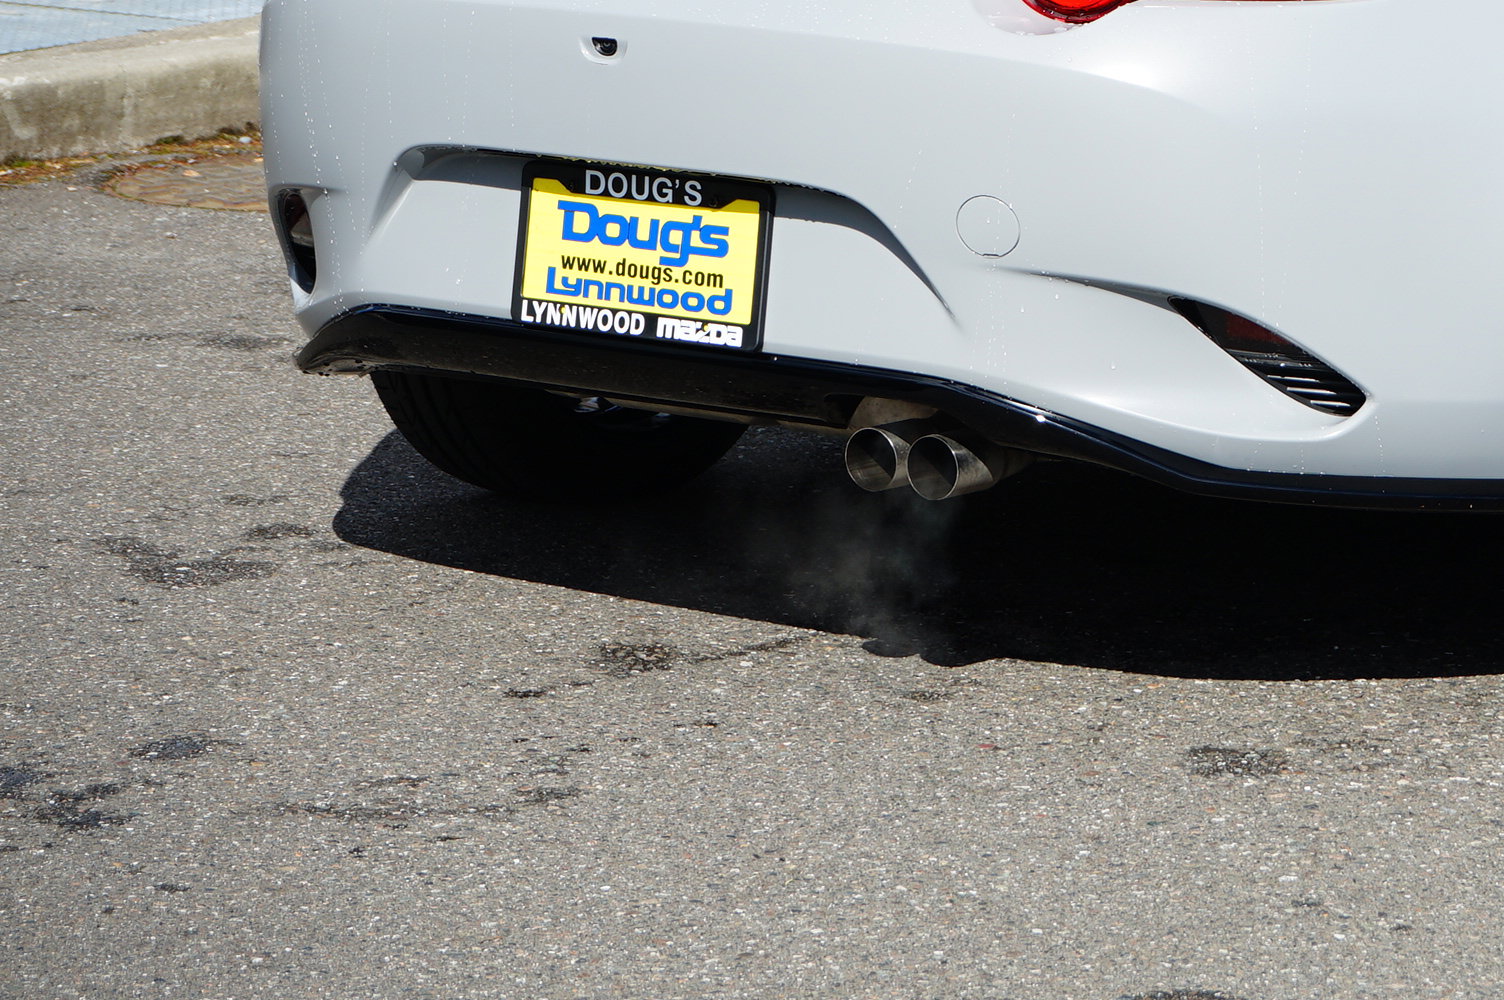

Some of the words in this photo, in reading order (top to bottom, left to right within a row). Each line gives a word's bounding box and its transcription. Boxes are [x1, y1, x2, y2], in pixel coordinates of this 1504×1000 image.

[584, 169, 703, 207] DOUG'S
[557, 199, 730, 268] Doug's
[560, 254, 724, 289] www.dougs.com
[545, 266, 734, 316] Lynnwood
[520, 299, 646, 336] LYNNWOOD
